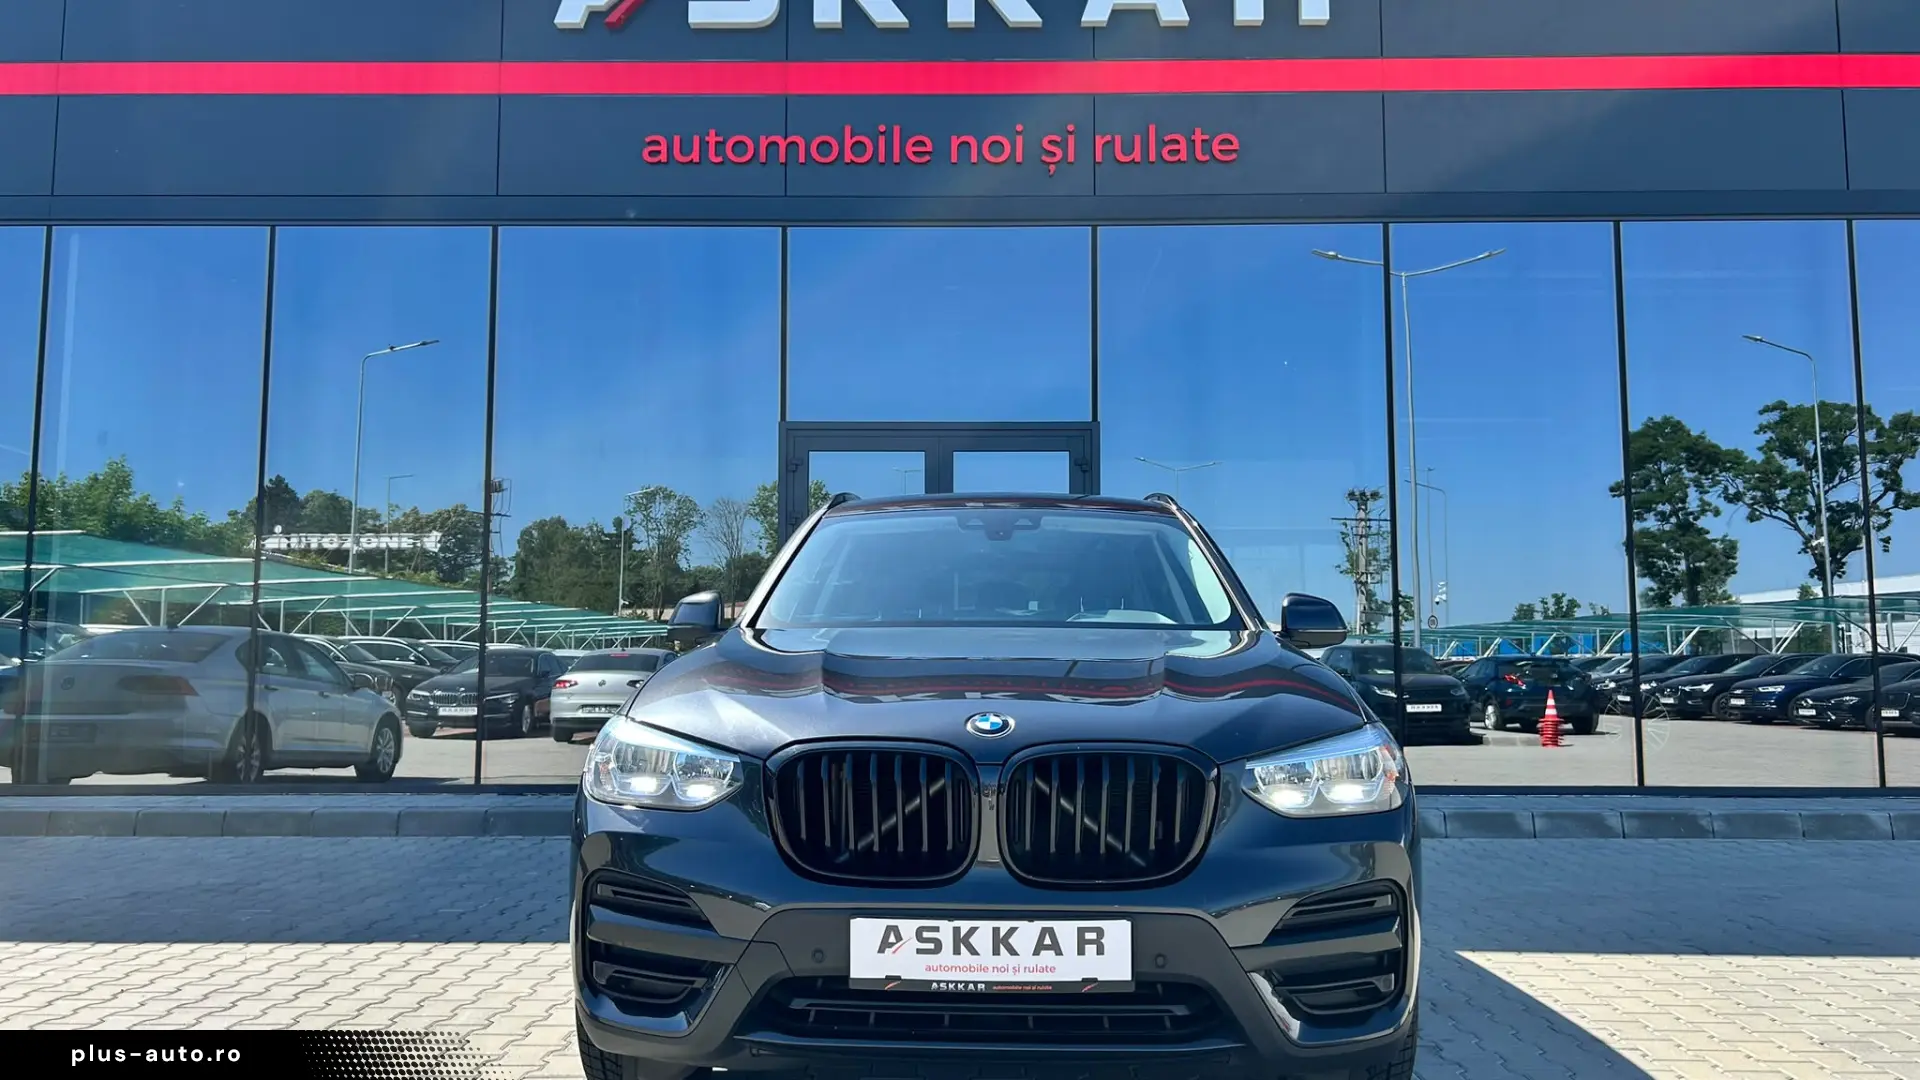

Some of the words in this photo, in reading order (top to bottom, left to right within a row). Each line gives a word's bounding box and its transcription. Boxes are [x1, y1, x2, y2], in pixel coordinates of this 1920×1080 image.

[641, 124, 933, 165] automobile
[950, 124, 1024, 164] noi
[1041, 124, 1076, 174] și
[1094, 124, 1240, 163] rulate
[876, 924, 1106, 957] ASKKAR
[924, 963, 990, 974] automobile
[992, 963, 1009, 974] noi
[1023, 963, 1056, 974] rulate
[930, 981, 986, 992] ASKKAR
